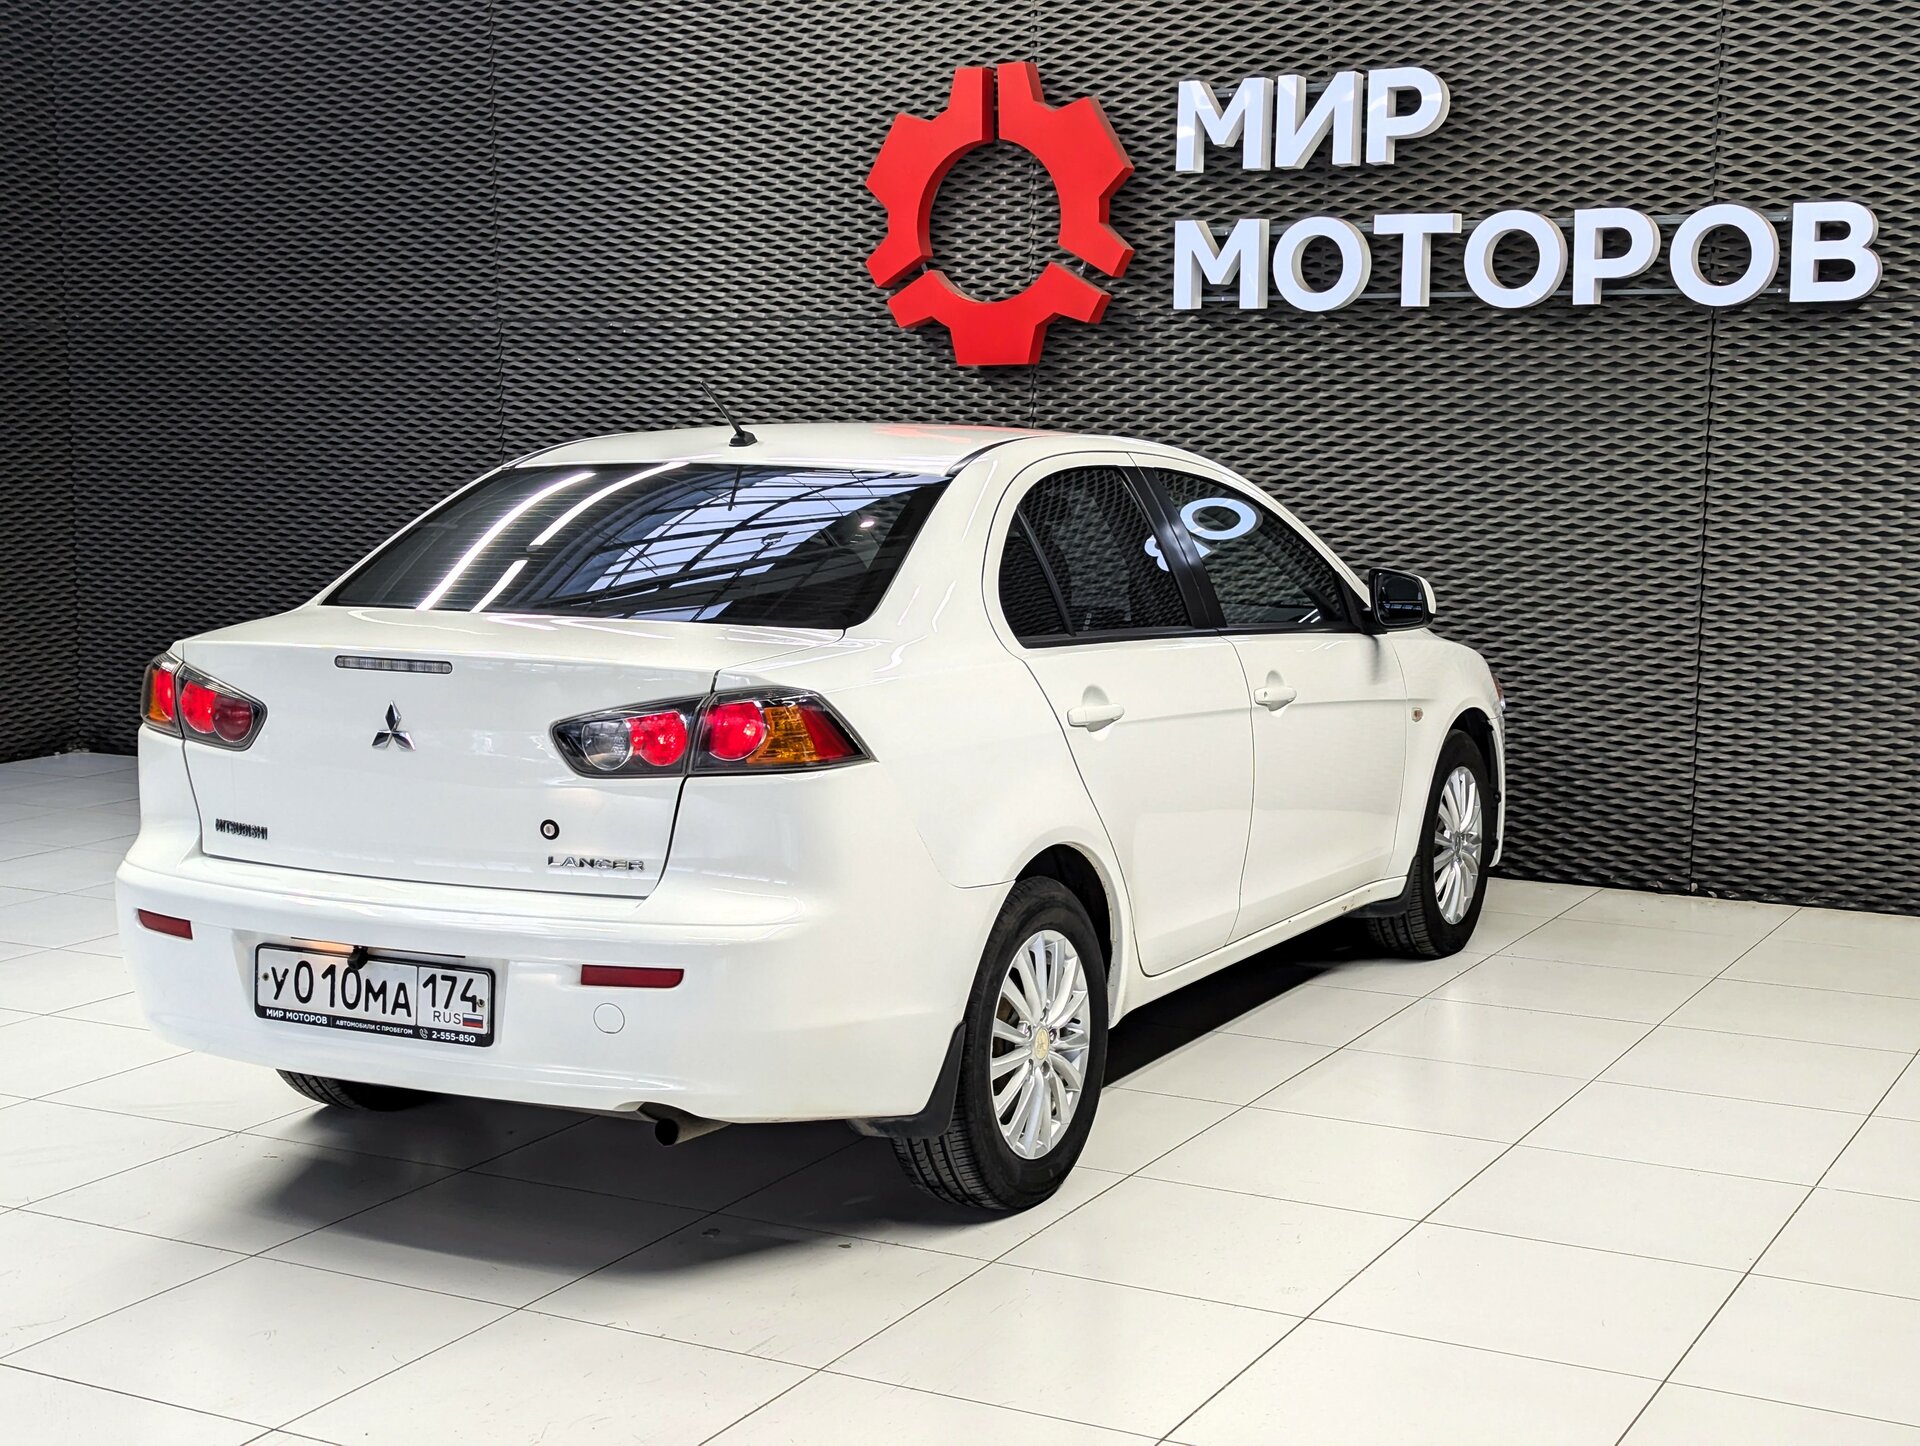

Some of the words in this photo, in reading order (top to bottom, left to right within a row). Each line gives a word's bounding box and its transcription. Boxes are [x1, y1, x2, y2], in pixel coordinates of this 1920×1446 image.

[1175, 66, 1451, 173] МИР
[1173, 201, 1883, 312] МОТОРОВ
[215, 818, 268, 840] MITSUBISHI
[547, 856, 645, 872] LANCER
[422, 973, 478, 1013] 174
[266, 1008, 284, 1018] МИР
[286, 1011, 328, 1025] МОТОРОВ
[335, 1019, 376, 1030] АВТОМОБИЛИ
[381, 1025, 413, 1035] ПРОБЕГОМ
[432, 1031, 476, 1043] 2-555-850
[432, 1010, 462, 1025] RUS
